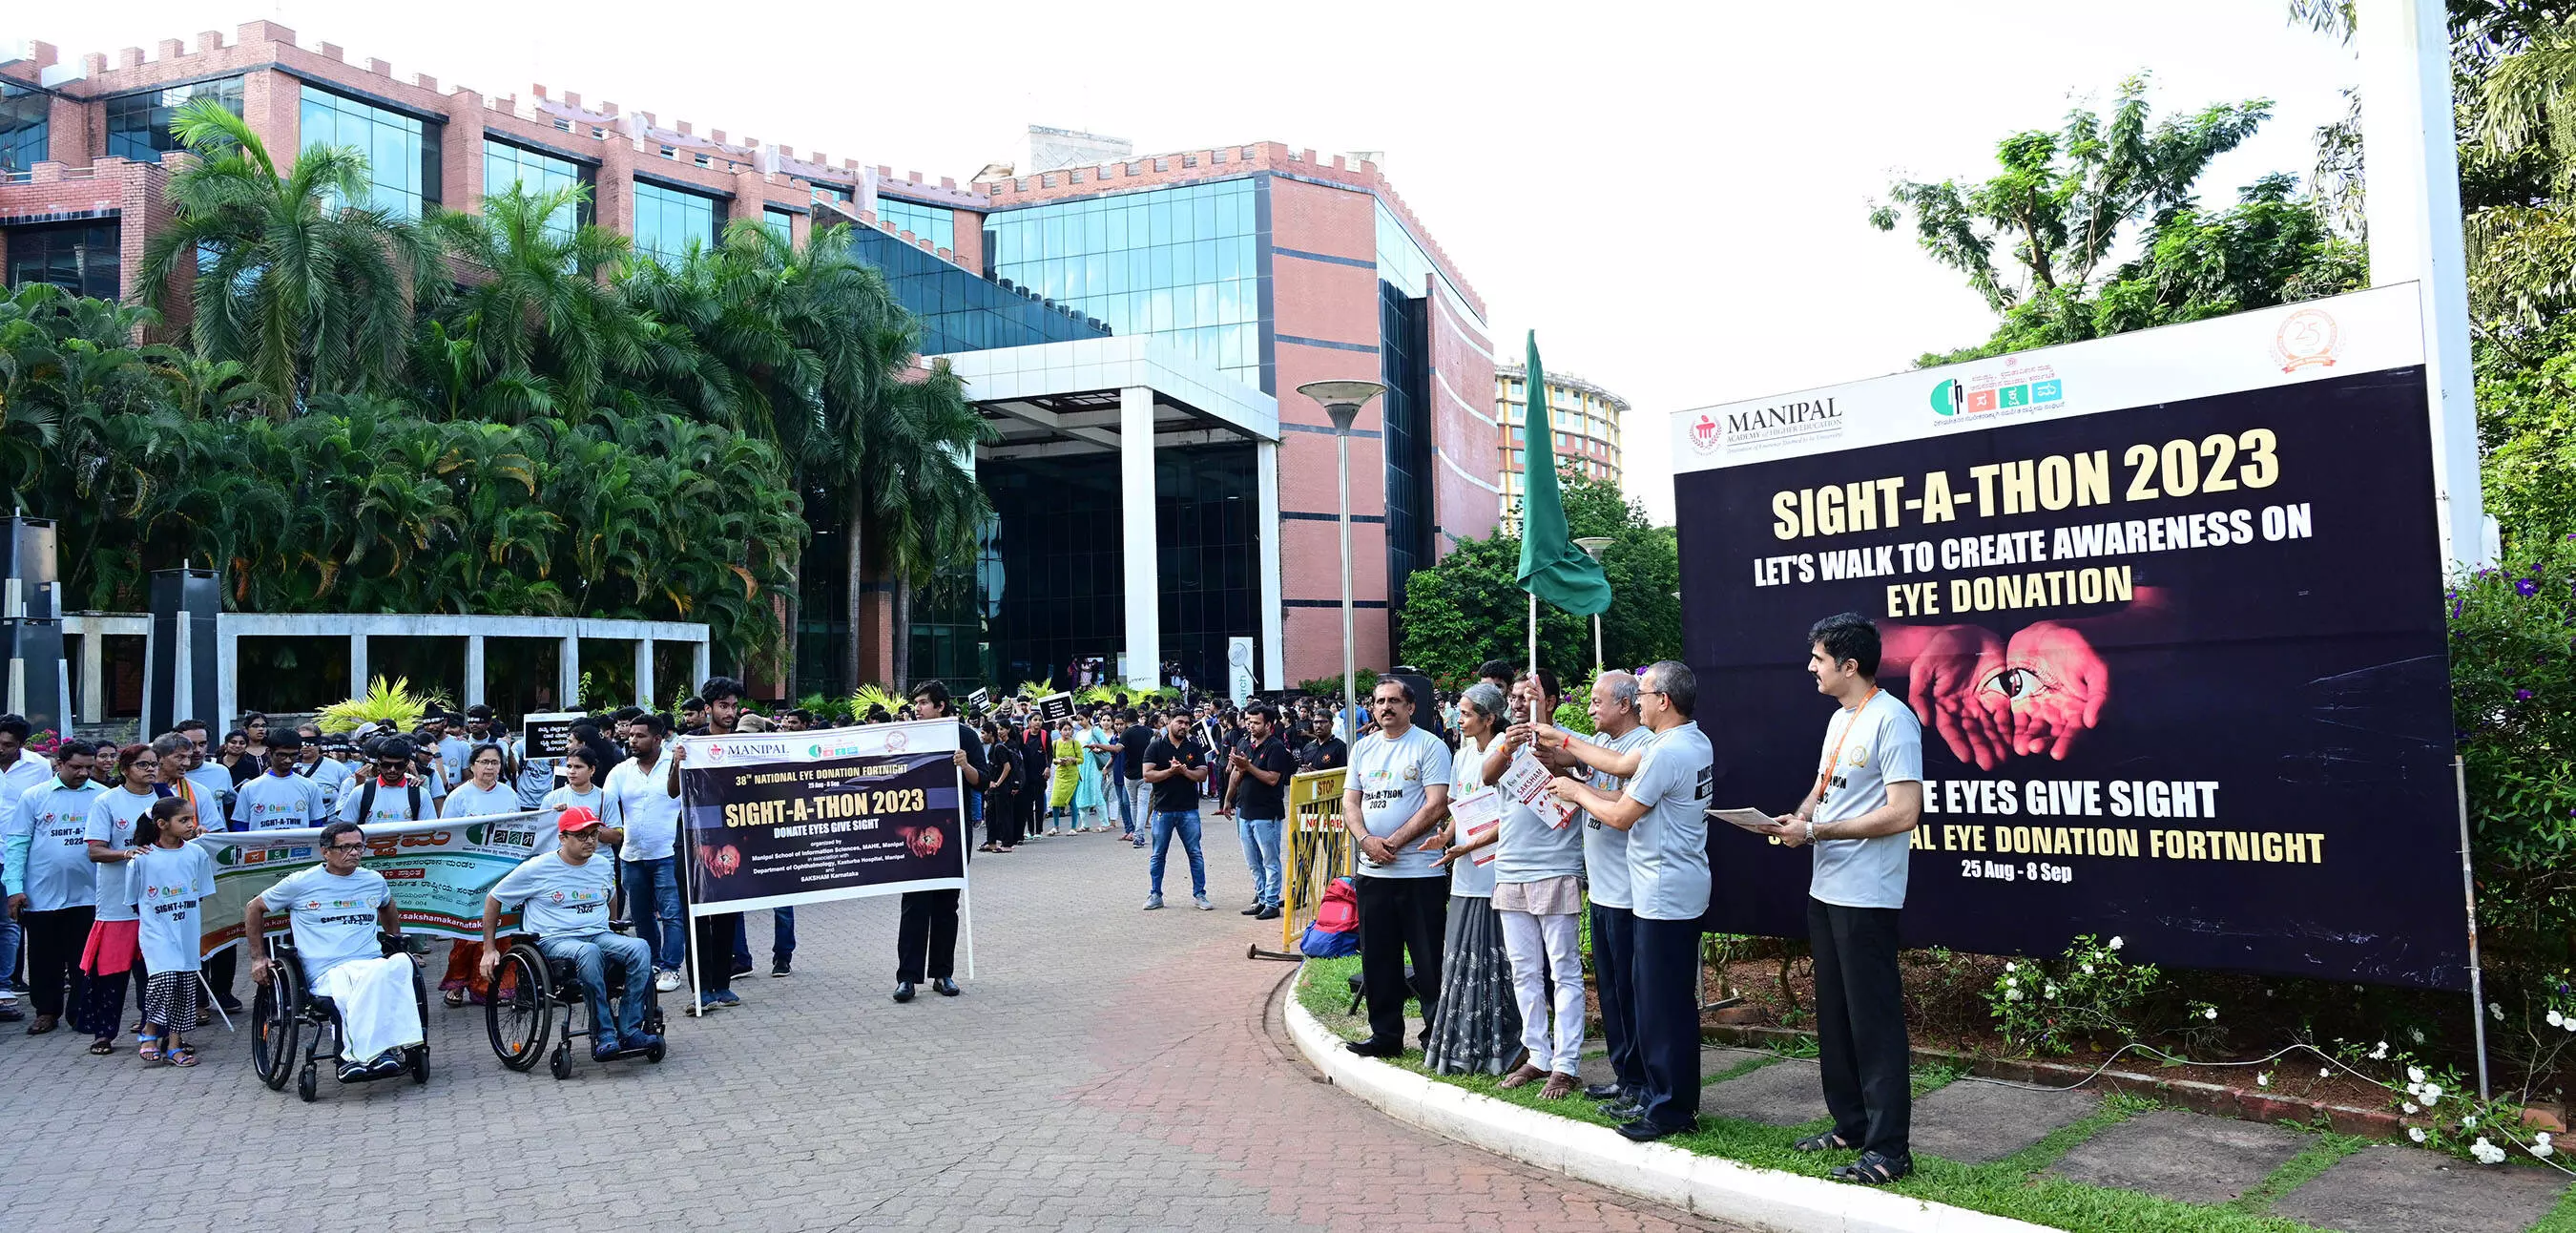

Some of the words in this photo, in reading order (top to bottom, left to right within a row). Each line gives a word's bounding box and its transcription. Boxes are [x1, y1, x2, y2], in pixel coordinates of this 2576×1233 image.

[1728, 396, 1843, 435] MANIPAL
[1726, 430, 1761, 444] ACADEMY
[1769, 426, 1798, 437] HIGHER
[1798, 418, 1843, 432] EDUCATION
[1772, 449, 2110, 541] SIGHT-A-THON
[2124, 428, 2279, 502] 2023
[1754, 554, 1816, 587] LET'S
[1818, 545, 1895, 581] WALK
[1899, 540, 1935, 573] TO
[1941, 530, 2046, 571] CREATE
[2052, 509, 2254, 560] AWARENESS
[2261, 502, 2313, 542] ON
[1886, 581, 1939, 618] EYE
[1950, 565, 2133, 614] DONATION
[727, 743, 788, 756] MANIPAL
[754, 771, 798, 784] NATIONAL
[800, 770, 814, 781] EYE
[816, 766, 860, 780] DONATION
[862, 763, 908, 777] FORTNIGHT
[1516, 768, 1544, 796] SAKSHAM
[1318, 780, 1335, 796] STOP
[1945, 779, 2018, 815] EYES
[2025, 780, 2103, 816] GIVE
[2109, 780, 2219, 818] SIGHT
[725, 792, 868, 828] SIGHT-A-THON
[872, 788, 924, 814] 2023
[1369, 800, 1387, 809] 2023
[774, 824, 808, 839] DONATE
[808, 823, 830, 836] EYES
[831, 820, 851, 833] GIVE
[852, 818, 880, 832] SIGHT
[64, 837, 84, 846] 2023
[752, 853, 774, 862] Manipal
[775, 851, 794, 860] School
[801, 847, 834, 857] Information
[882, 841, 904, 849] Manipal
[1943, 825, 1986, 852] EYE
[1995, 826, 2139, 857] DONATION
[2150, 829, 2325, 864] FORTNIGHT
[753, 865, 785, 874] Department
[884, 853, 905, 862] Manipal
[1961, 859, 1983, 878] 25
[1984, 860, 2015, 882] Aug
[2026, 862, 2038, 880] 8
[2041, 862, 2072, 883] Sep
[800, 873, 830, 883] SAKSHAM
[830, 870, 859, 879] Karnataka
